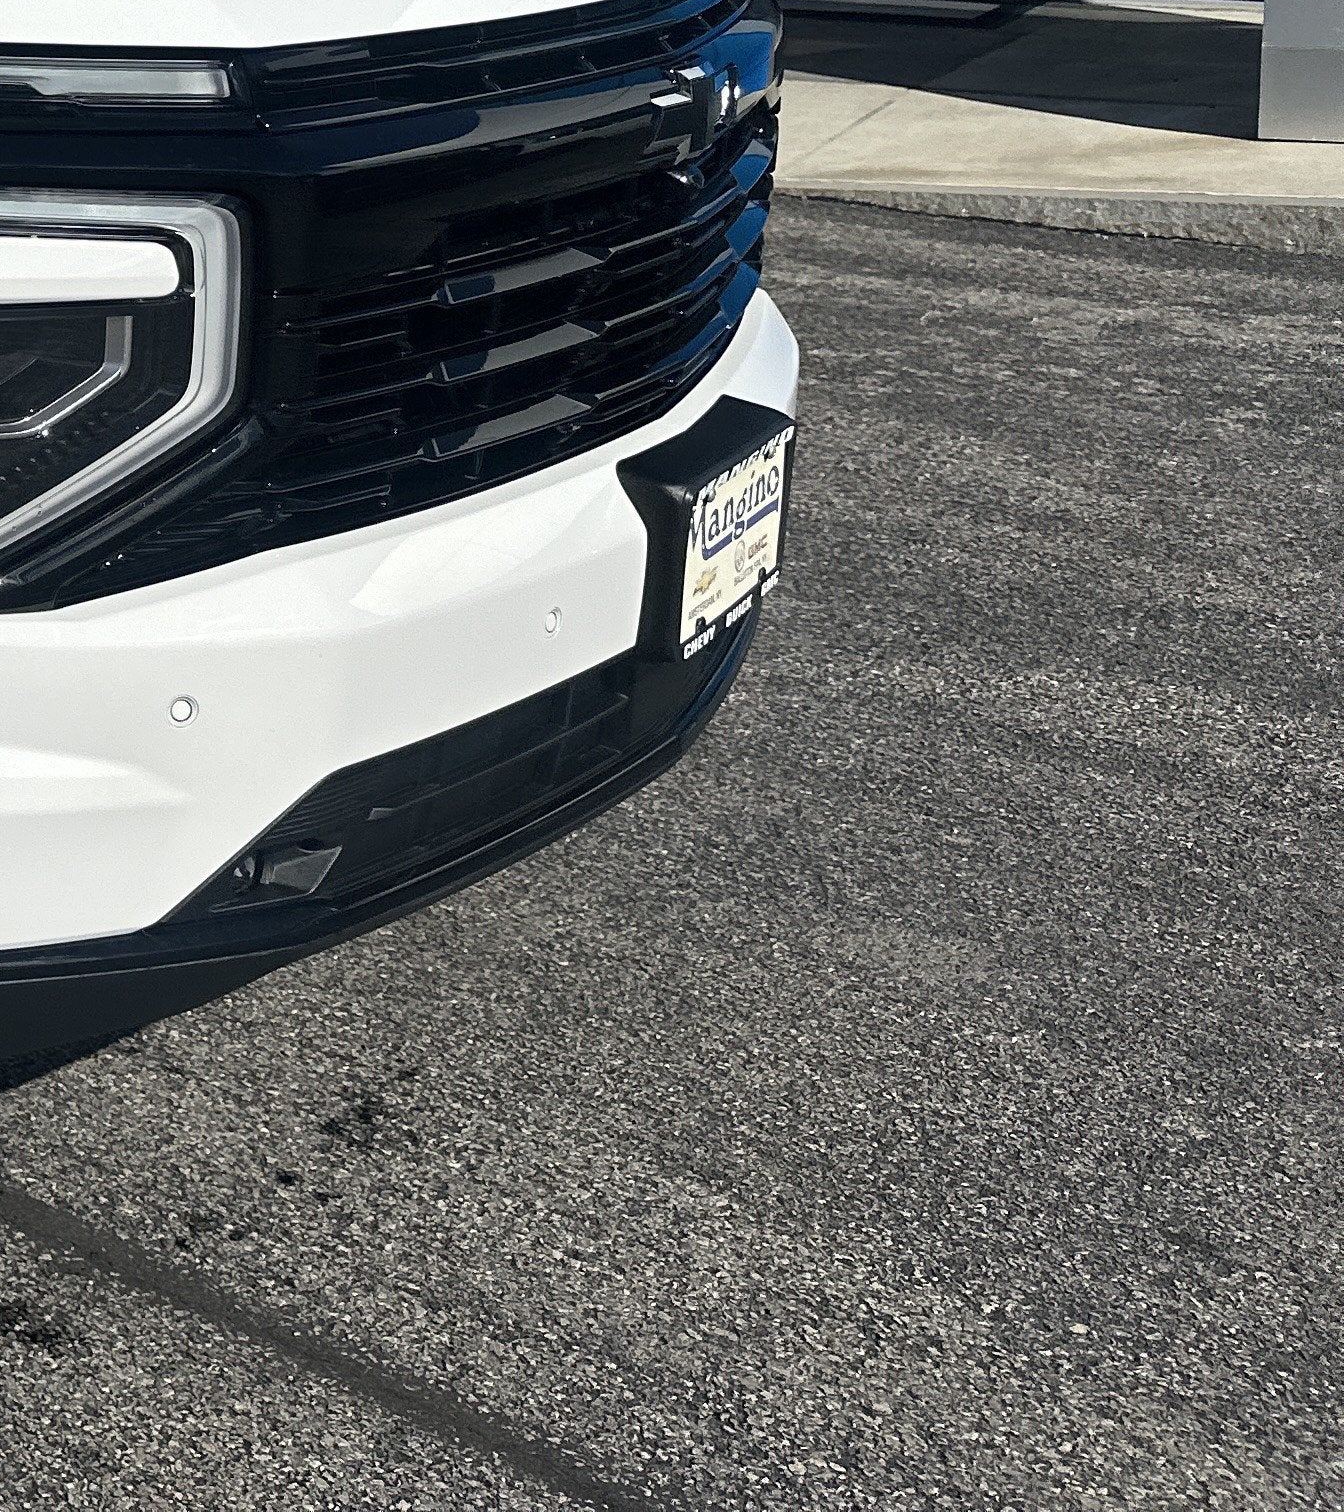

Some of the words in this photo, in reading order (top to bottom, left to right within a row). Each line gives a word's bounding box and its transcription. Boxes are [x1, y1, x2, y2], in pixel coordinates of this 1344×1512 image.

[690, 465, 780, 560] Mangino
[683, 624, 716, 660] CHEVY
[725, 593, 753, 628] BUICK
